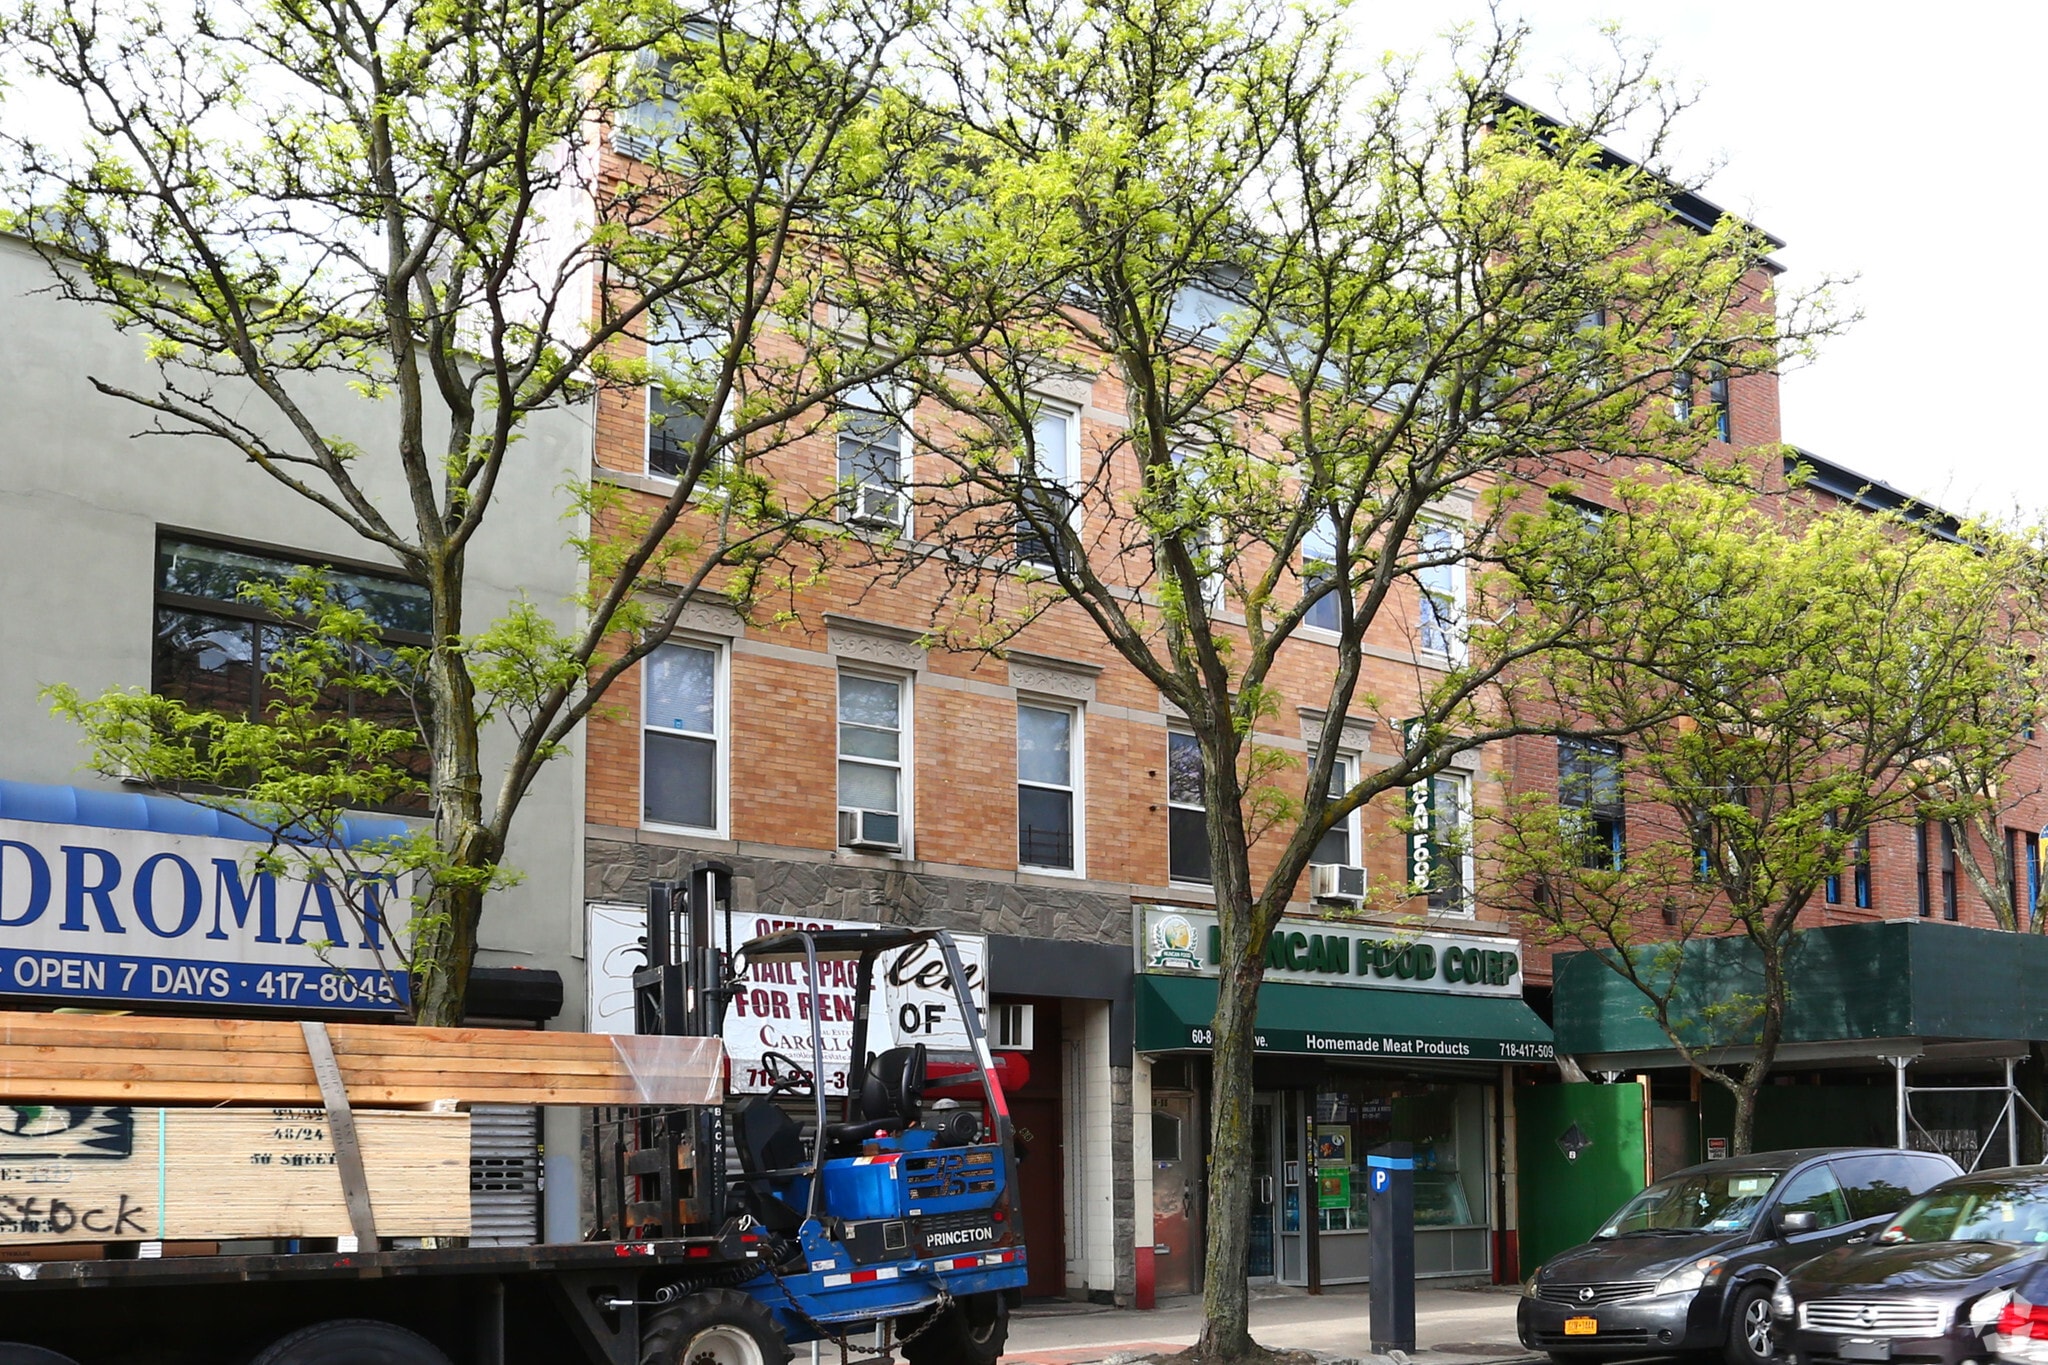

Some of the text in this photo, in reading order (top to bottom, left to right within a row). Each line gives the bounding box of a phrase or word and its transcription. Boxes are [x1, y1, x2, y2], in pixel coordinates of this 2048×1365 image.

[0, 839, 399, 950] DROMAT
[1209, 925, 1519, 985] NCAN FOOD CORP
[13, 956, 394, 1003] OPEN 7 DAYS 417-8045
[735, 989, 856, 1022] FOR REN
[900, 1003, 946, 1033] OF
[1306, 1035, 1470, 1055] Homemade Meat Products
[273, 1128, 323, 1141] 48/24
[714, 1107, 723, 1153] BACK
[1376, 1171, 1386, 1190] P
[926, 1227, 993, 1248] PRINCETON
